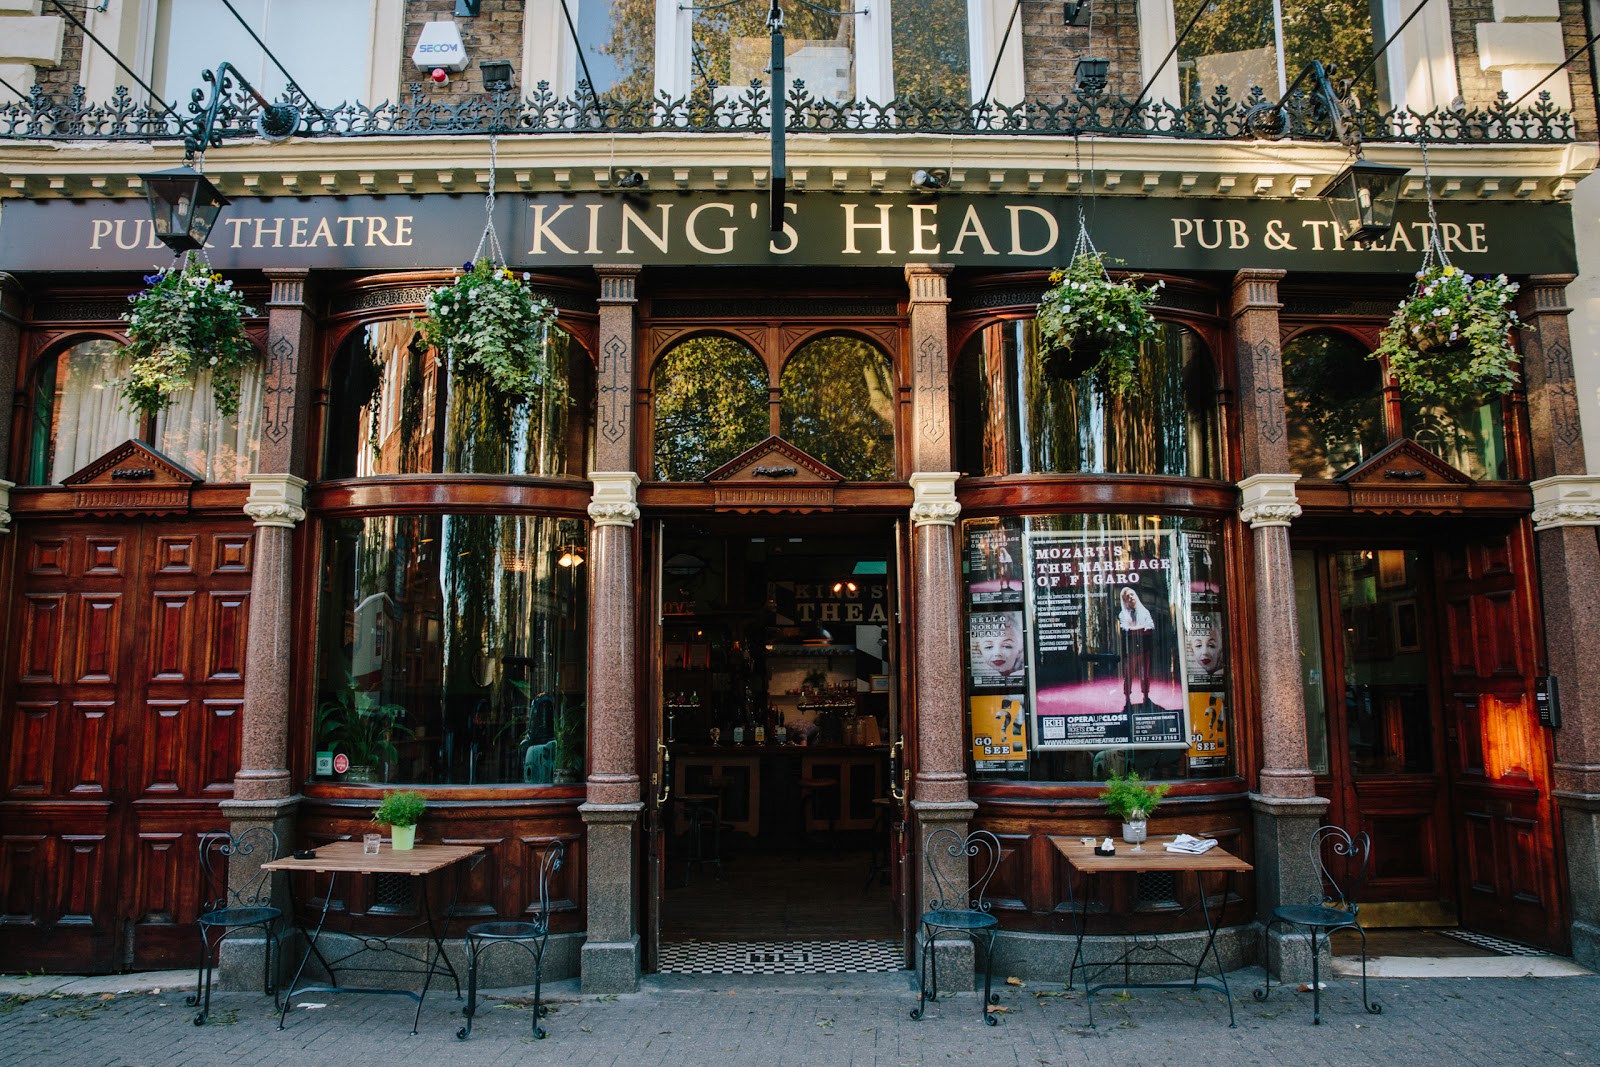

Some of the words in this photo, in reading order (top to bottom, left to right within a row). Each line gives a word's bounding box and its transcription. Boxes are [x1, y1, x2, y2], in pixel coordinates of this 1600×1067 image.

[419, 44, 458, 53] SECOM
[224, 216, 413, 248] THEATRE
[528, 202, 799, 255] KING'S
[839, 203, 1059, 256] HEAD
[1170, 218, 1250, 249] PUB
[1263, 219, 1298, 251] &
[1035, 546, 1122, 560] MOZART'S
[1036, 563, 1071, 574] THE
[1078, 558, 1170, 573] MARRIAGE
[1036, 576, 1060, 587] OF
[1069, 573, 1139, 586] FIGARO
[1045, 719, 1063, 727] KH
[1067, 714, 1128, 722] OPERAUPCLOSE
[975, 737, 992, 746] GO
[1197, 742, 1216, 751] SEE
[984, 746, 1010, 754] SEE
